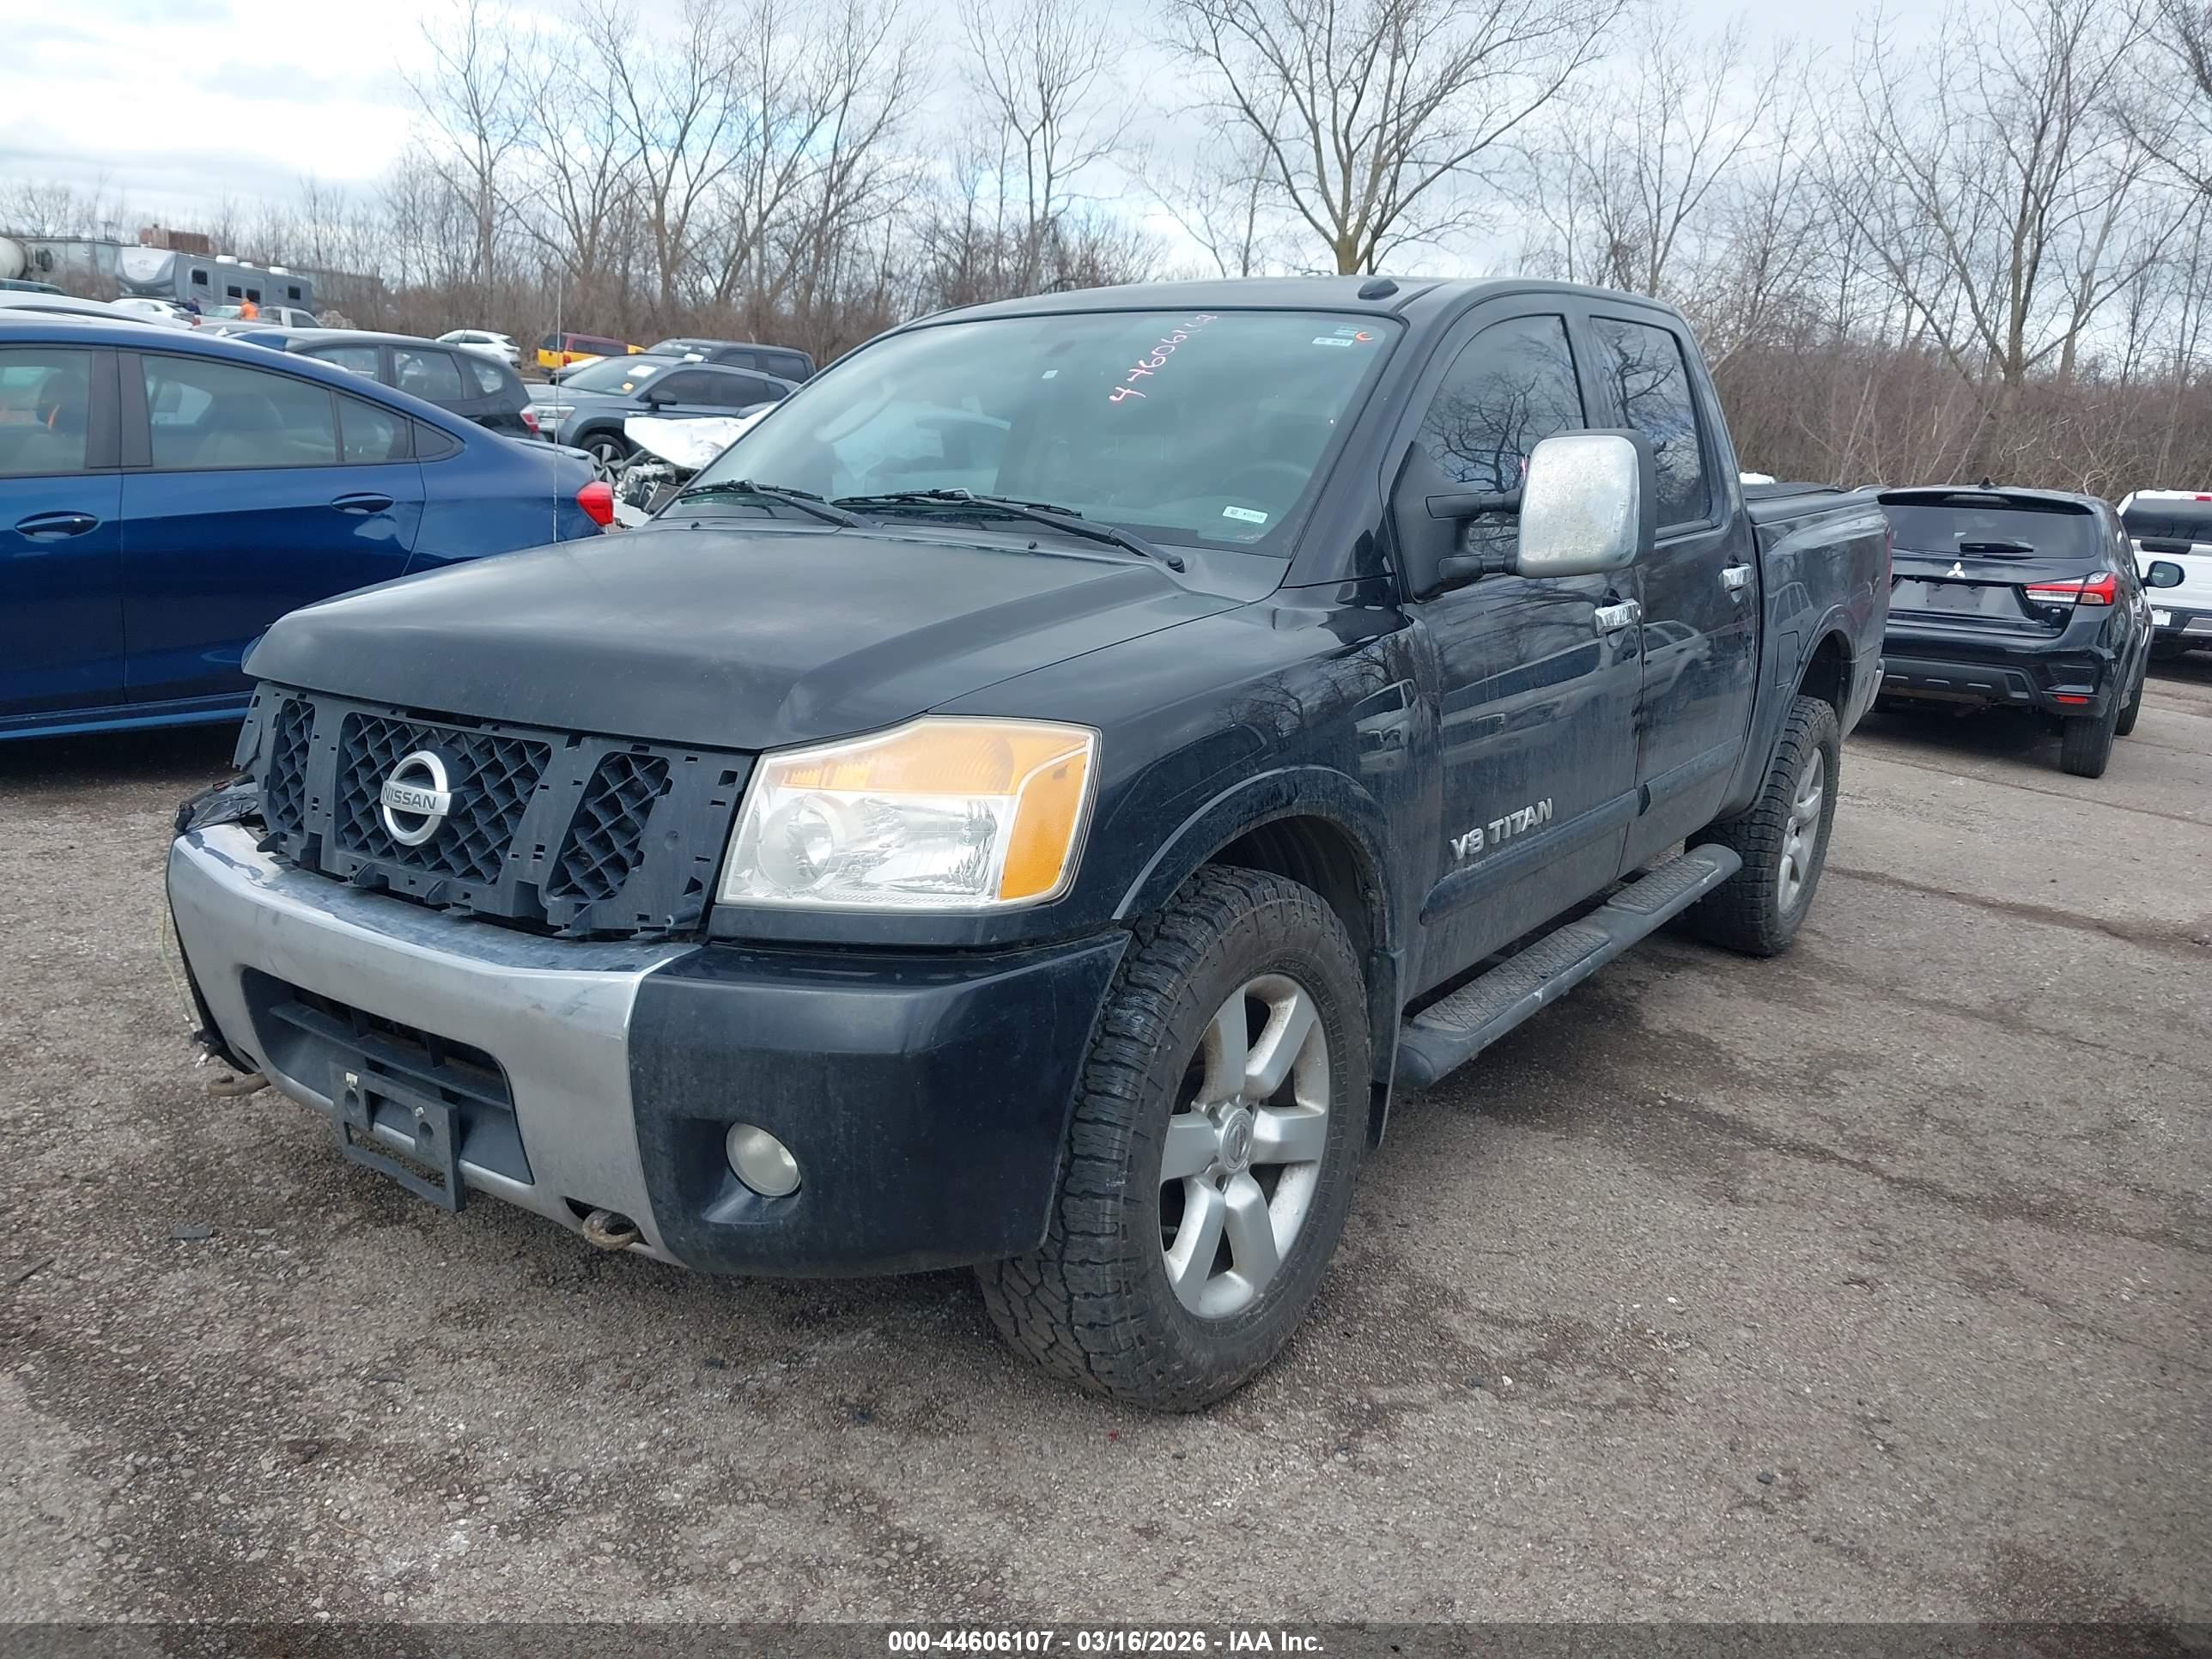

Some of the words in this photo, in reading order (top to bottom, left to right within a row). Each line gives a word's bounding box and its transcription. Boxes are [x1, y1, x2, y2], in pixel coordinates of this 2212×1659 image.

[382, 787, 437, 810] NISSAN
[1449, 828, 1485, 860] V8
[1487, 798, 1553, 844] TITAN
